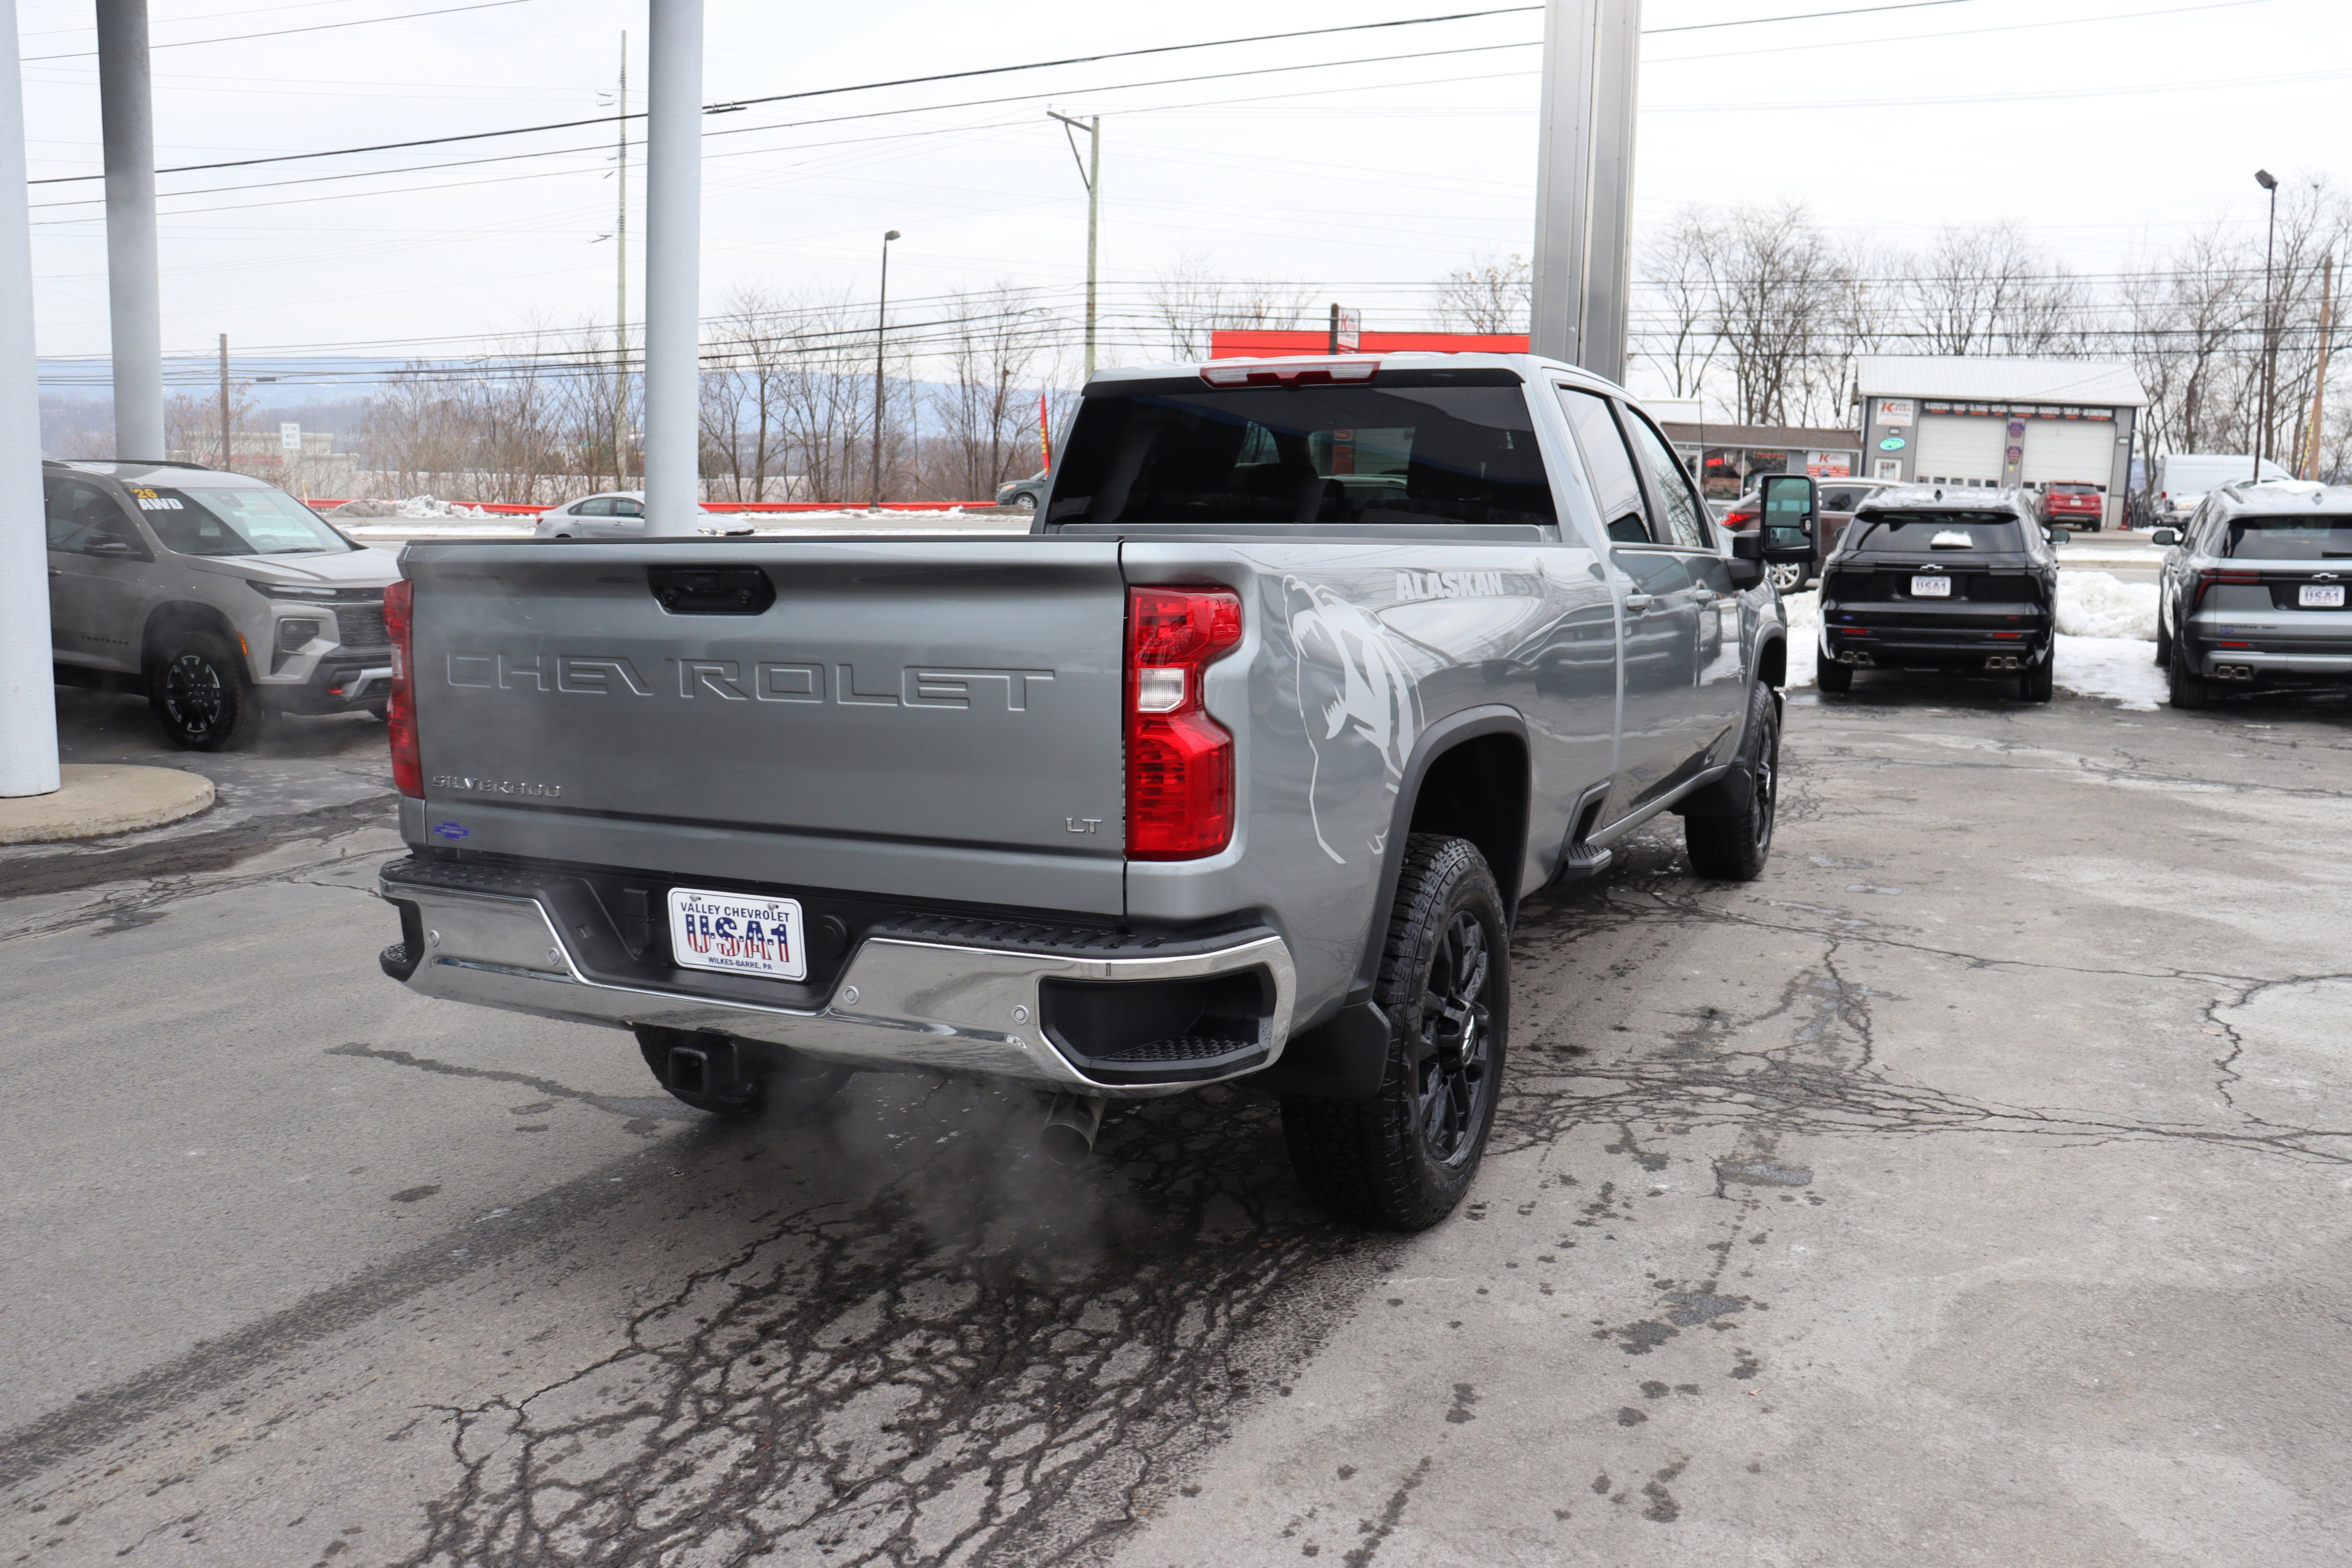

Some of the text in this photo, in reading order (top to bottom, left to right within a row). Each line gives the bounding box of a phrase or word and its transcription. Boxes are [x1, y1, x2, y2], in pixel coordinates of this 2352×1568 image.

[129, 488, 158, 498] '26
[137, 498, 184, 510] AWD
[1396, 572, 1504, 600] ALASKAN
[81, 635, 129, 645] TRAVERSE
[446, 652, 1056, 711] CHEVROLET
[432, 775, 561, 798] SILVERADO
[1066, 817, 1102, 833] LT
[680, 902, 790, 922] VALLEY CHEVROLET
[708, 956, 762, 970] WILKES-BARRE,
